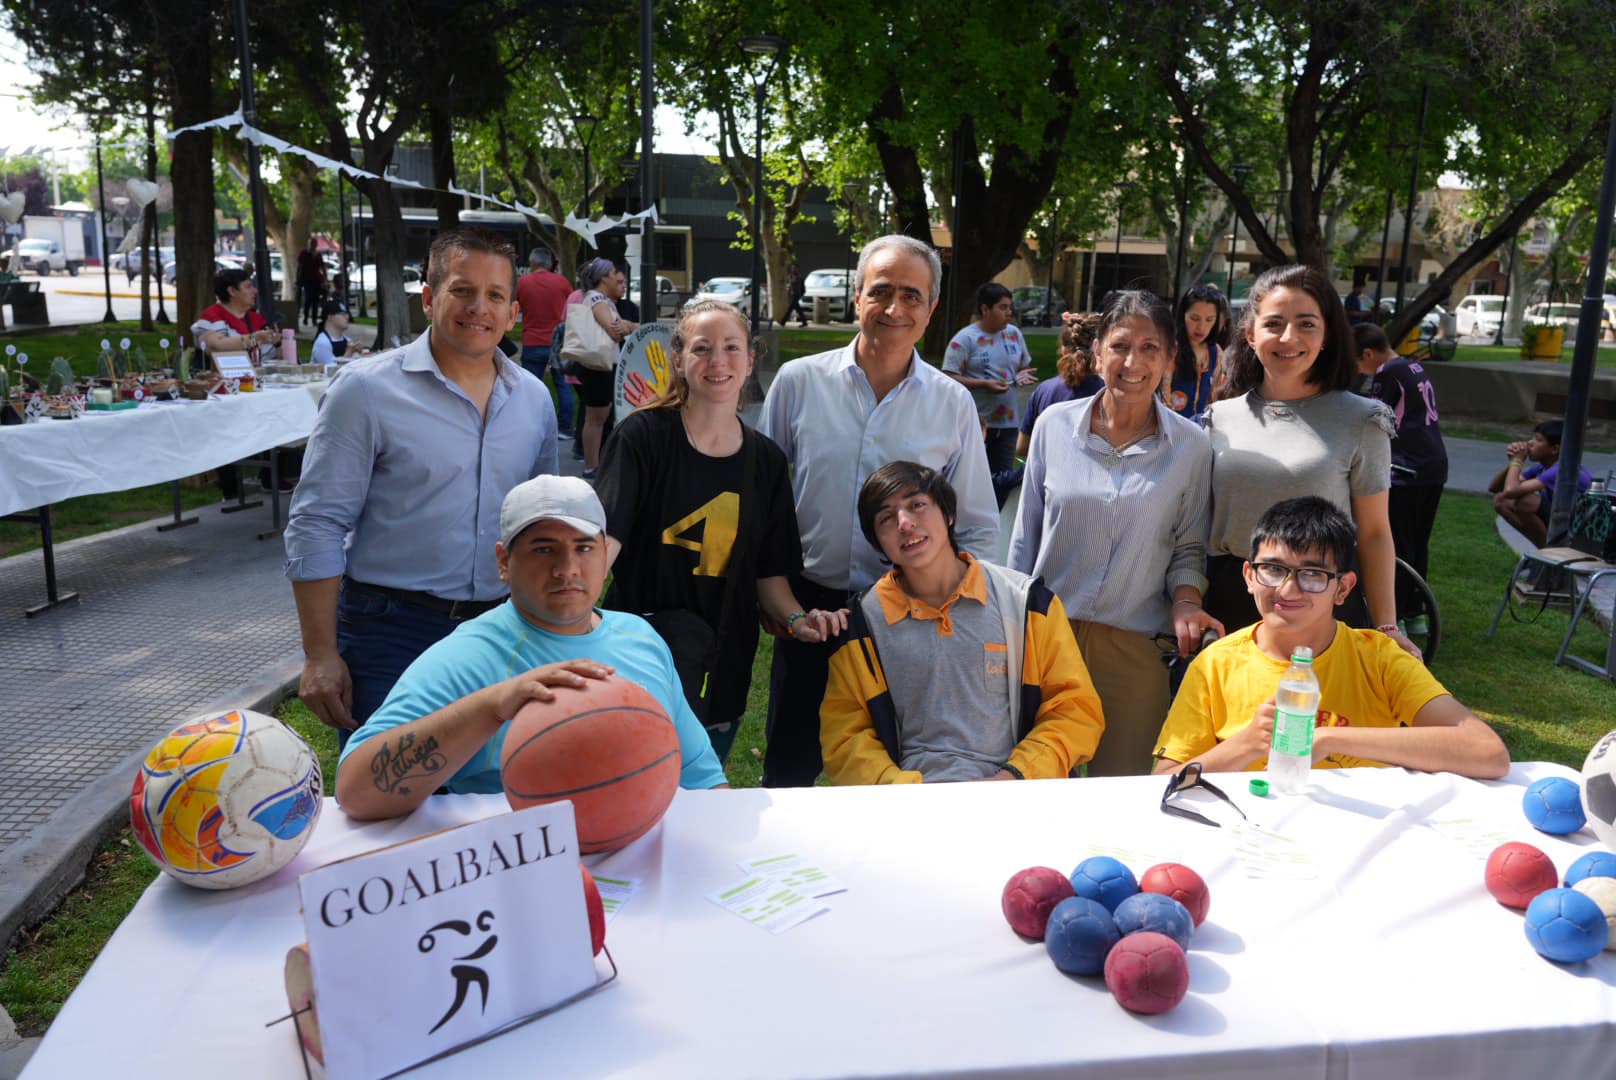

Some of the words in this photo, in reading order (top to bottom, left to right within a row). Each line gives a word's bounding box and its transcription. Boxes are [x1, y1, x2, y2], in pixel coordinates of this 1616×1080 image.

[616, 359, 626, 406] Escuela
[626, 341, 635, 354] de
[1417, 380, 1439, 426] 10
[662, 491, 740, 577] 4
[320, 824, 566, 928] GOALBALL
